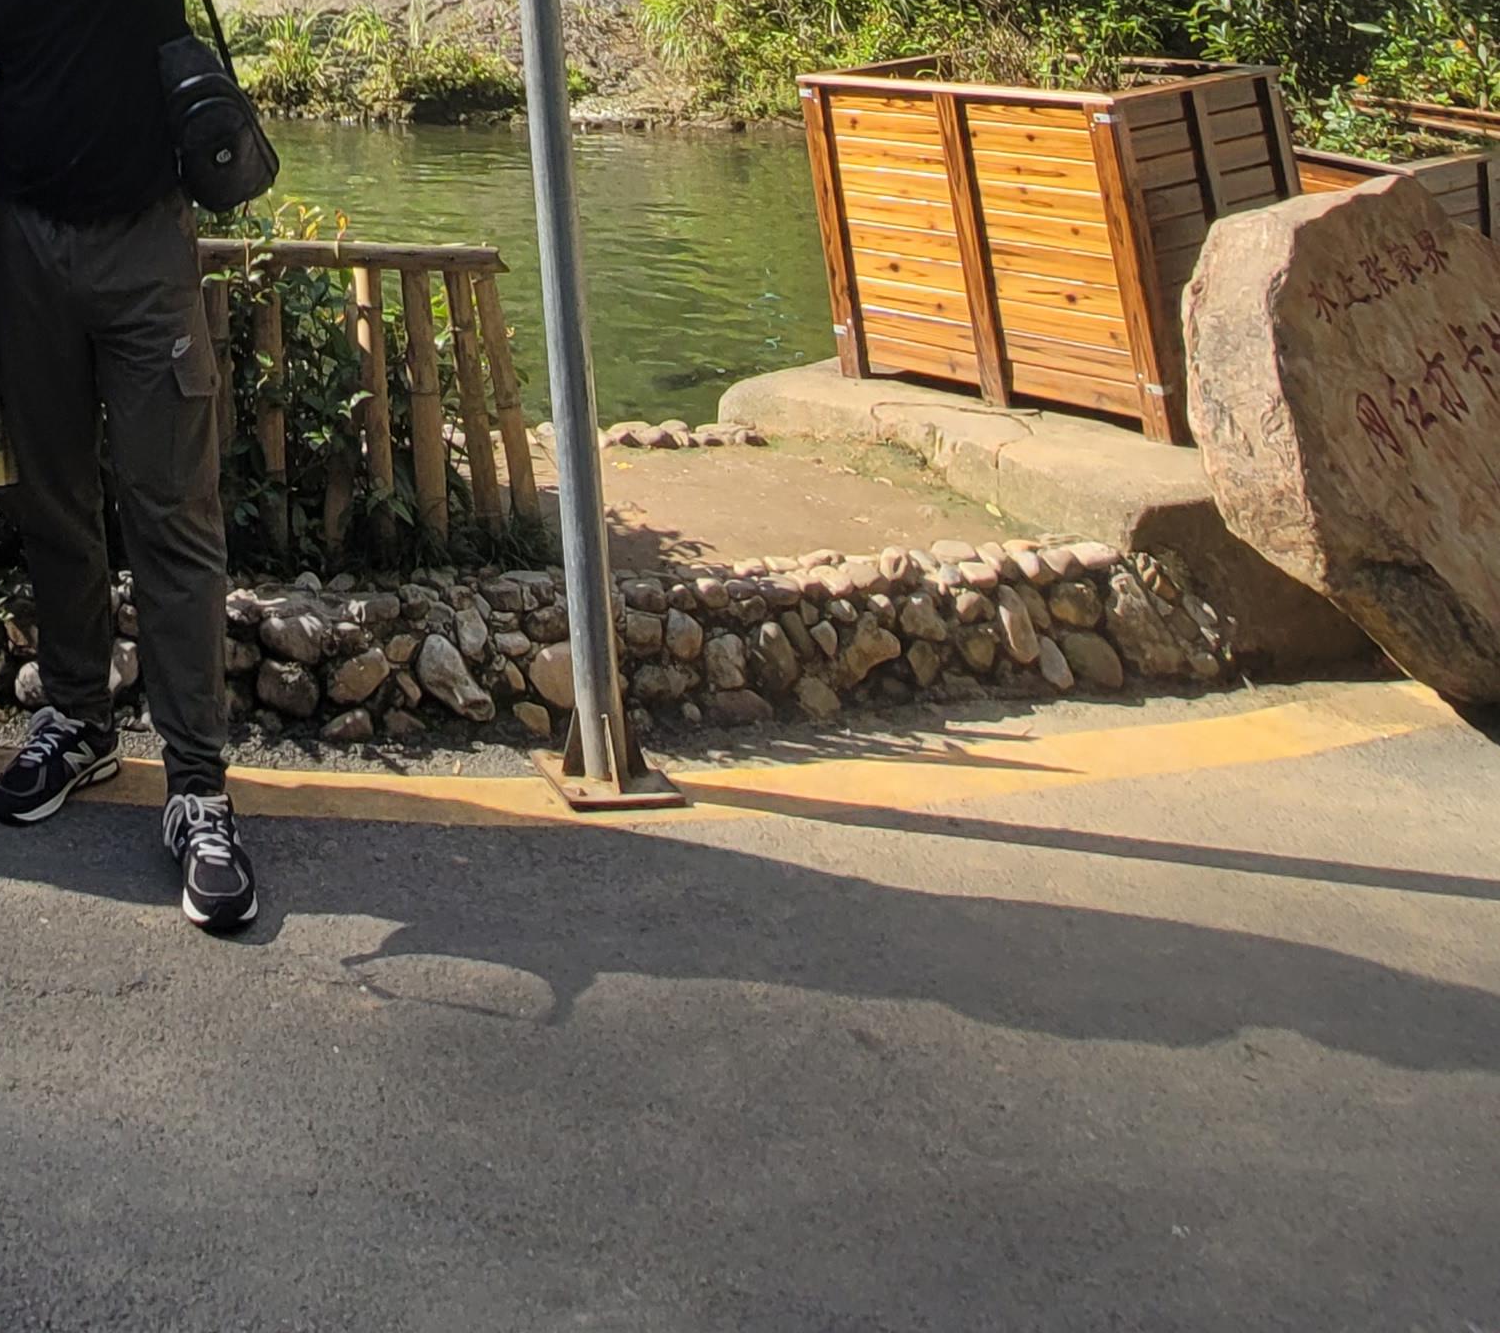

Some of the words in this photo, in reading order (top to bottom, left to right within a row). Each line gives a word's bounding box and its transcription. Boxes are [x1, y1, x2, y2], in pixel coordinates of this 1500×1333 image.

[1308, 229, 1449, 325] 水上张家界
